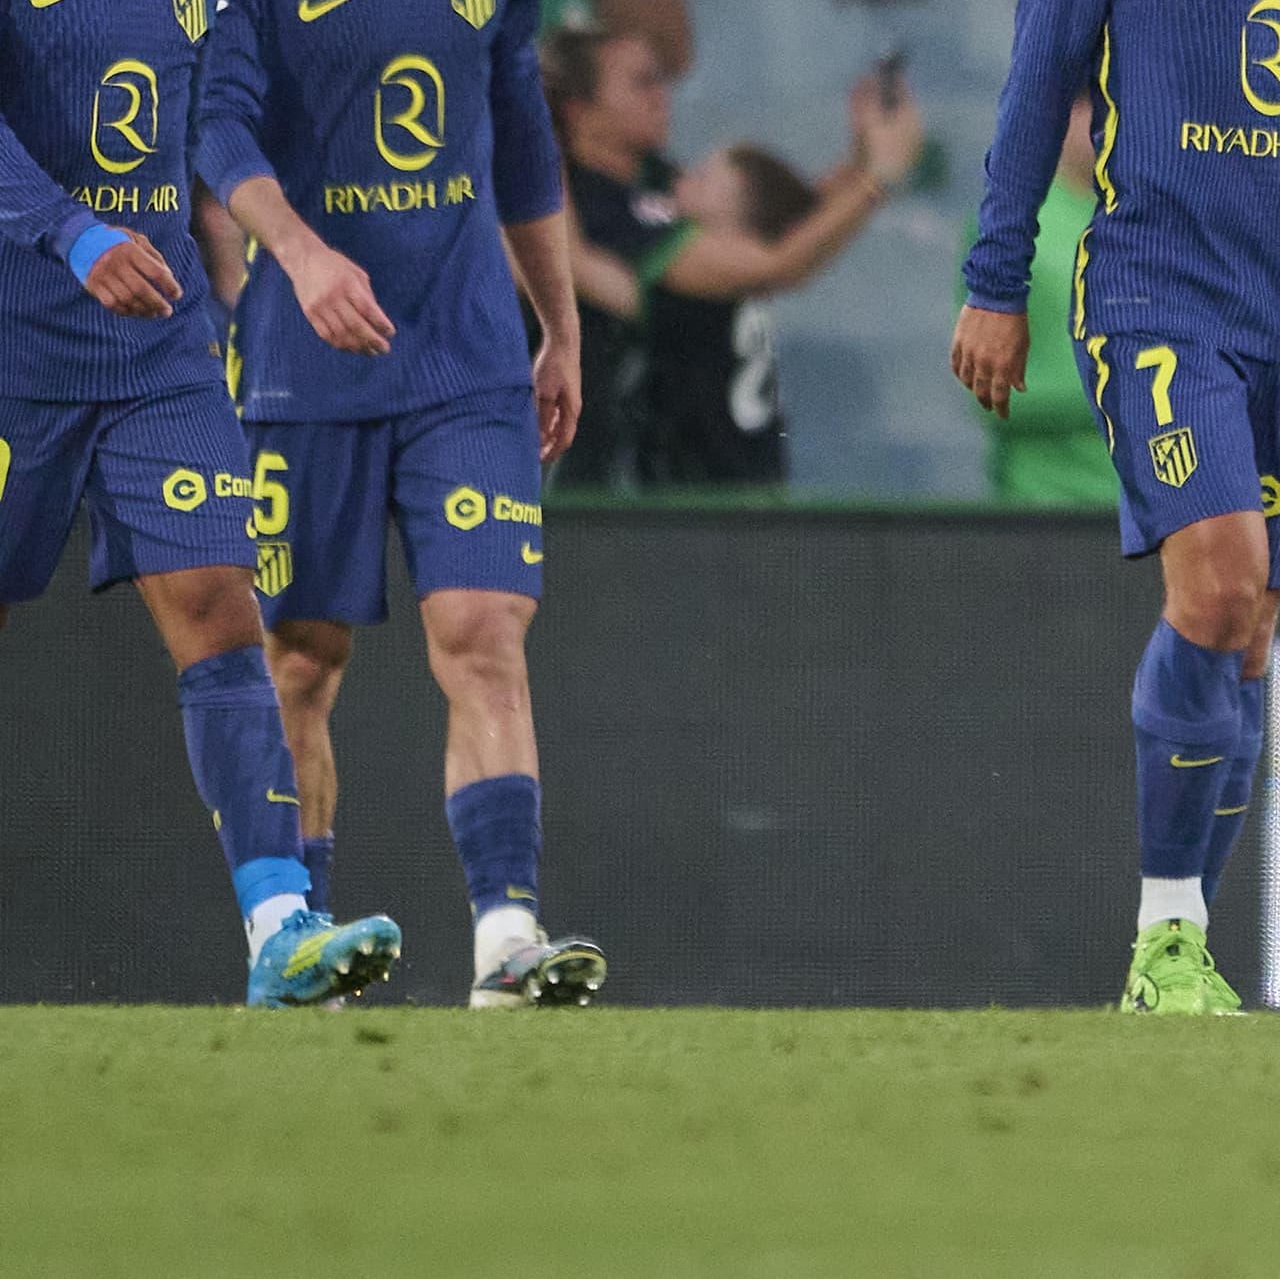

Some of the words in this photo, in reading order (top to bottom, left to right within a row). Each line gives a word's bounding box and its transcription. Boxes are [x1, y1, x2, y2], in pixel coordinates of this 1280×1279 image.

[144, 184, 180, 213] AIR
[324, 180, 437, 215] RIYADH
[443, 172, 477, 206] AIR
[1136, 345, 1178, 427] 7
[254, 452, 289, 536] 5
